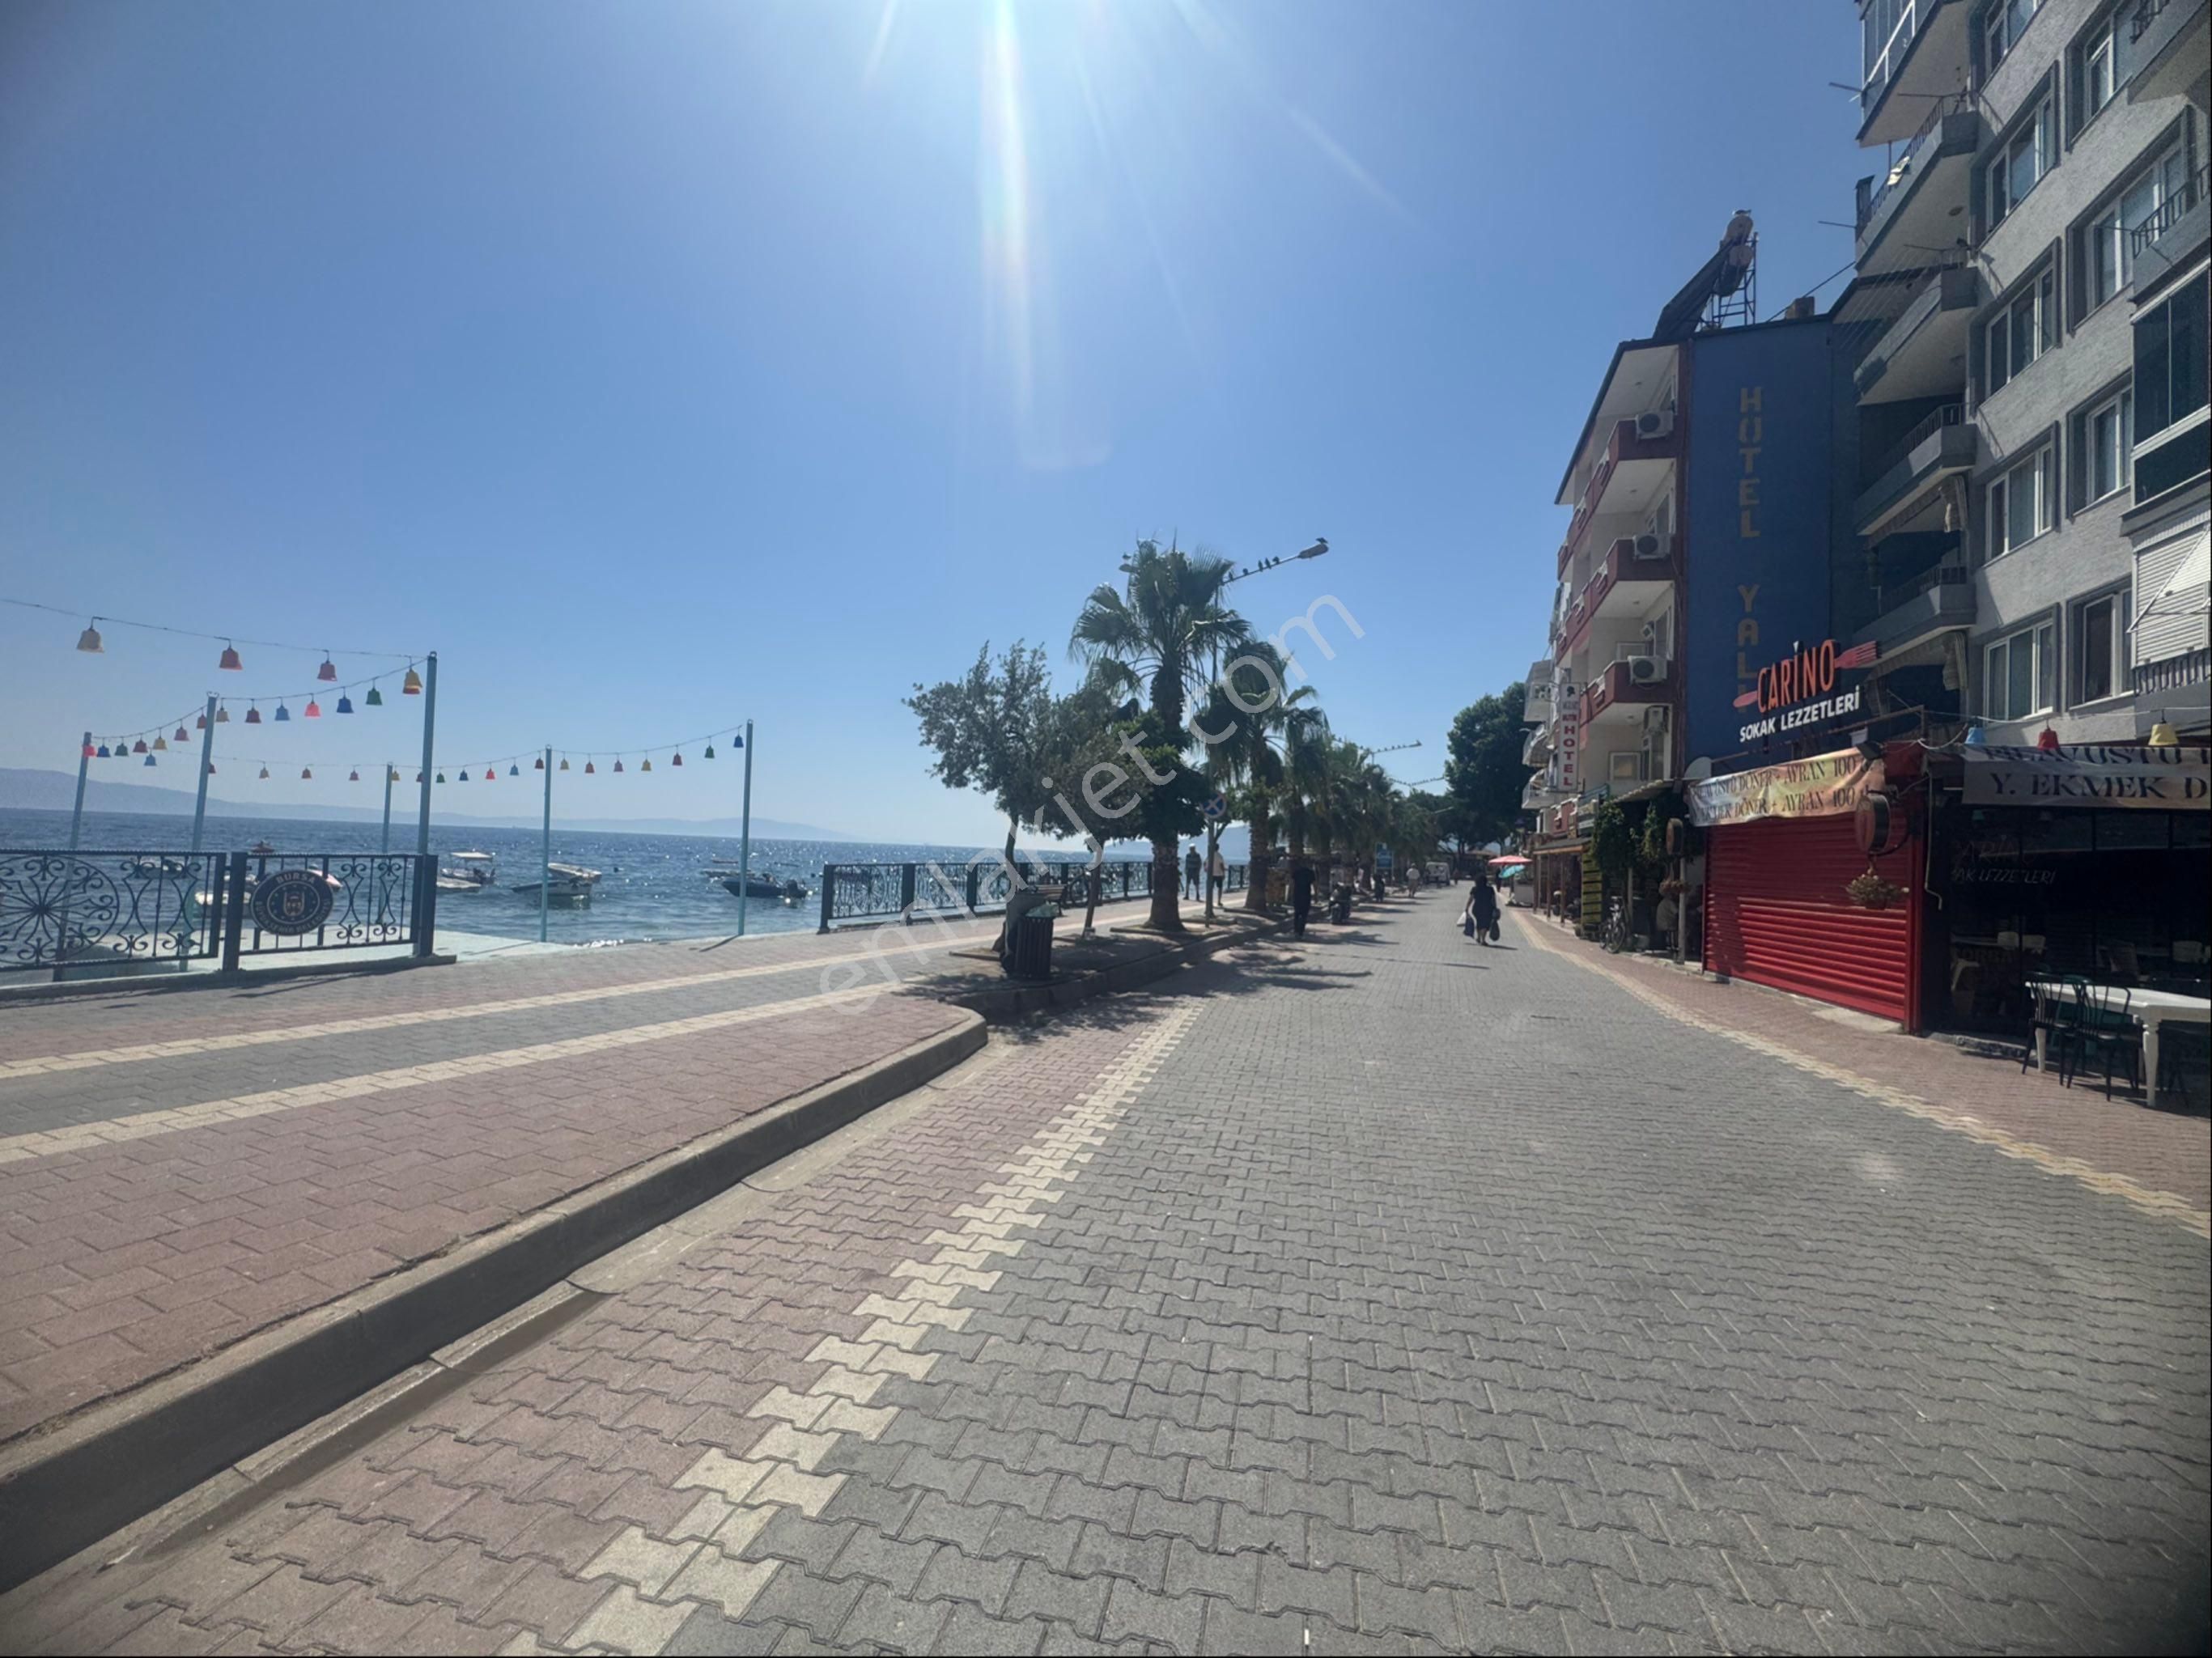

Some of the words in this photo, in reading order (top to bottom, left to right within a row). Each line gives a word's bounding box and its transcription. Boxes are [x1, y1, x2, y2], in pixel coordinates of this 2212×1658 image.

[1757, 638, 1836, 714] CARİNO
[1739, 717, 1776, 743] SOKAK
[1781, 684, 1860, 731] LEZZETLERİ
[1563, 725, 1575, 786] HOTEL
[1784, 760, 1826, 784] AYRAN
[1834, 756, 1857, 778] 100
[1782, 790, 1825, 812] AYRAN
[1832, 787, 1856, 808] 100
[1989, 773, 2016, 795] Y.
[2031, 774, 2167, 799] EKMEK
[275, 871, 315, 884] BURSA
